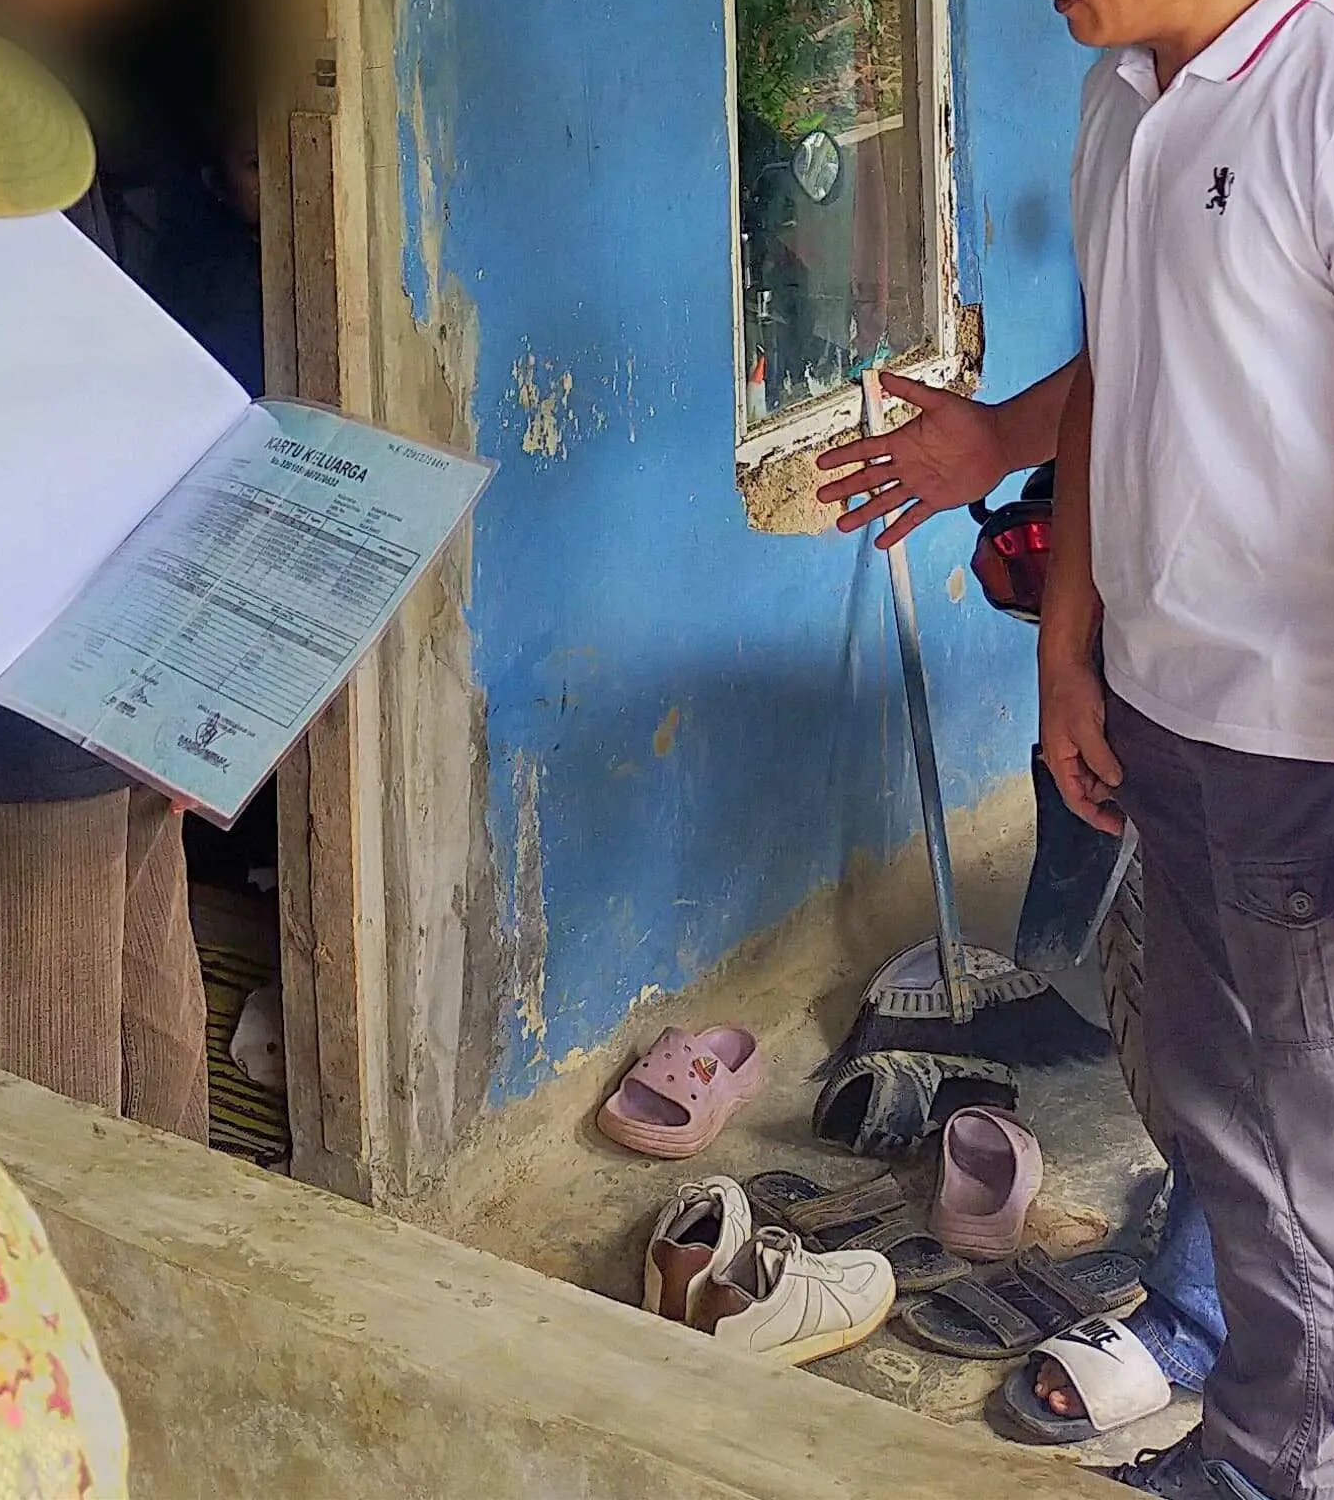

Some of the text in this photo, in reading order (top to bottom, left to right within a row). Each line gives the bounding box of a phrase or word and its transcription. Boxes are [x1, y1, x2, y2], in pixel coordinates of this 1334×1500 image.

[263, 436, 305, 458] KARTU
[301, 446, 369, 484] KELUARGA
[1075, 1317, 1123, 1349] NIKE
